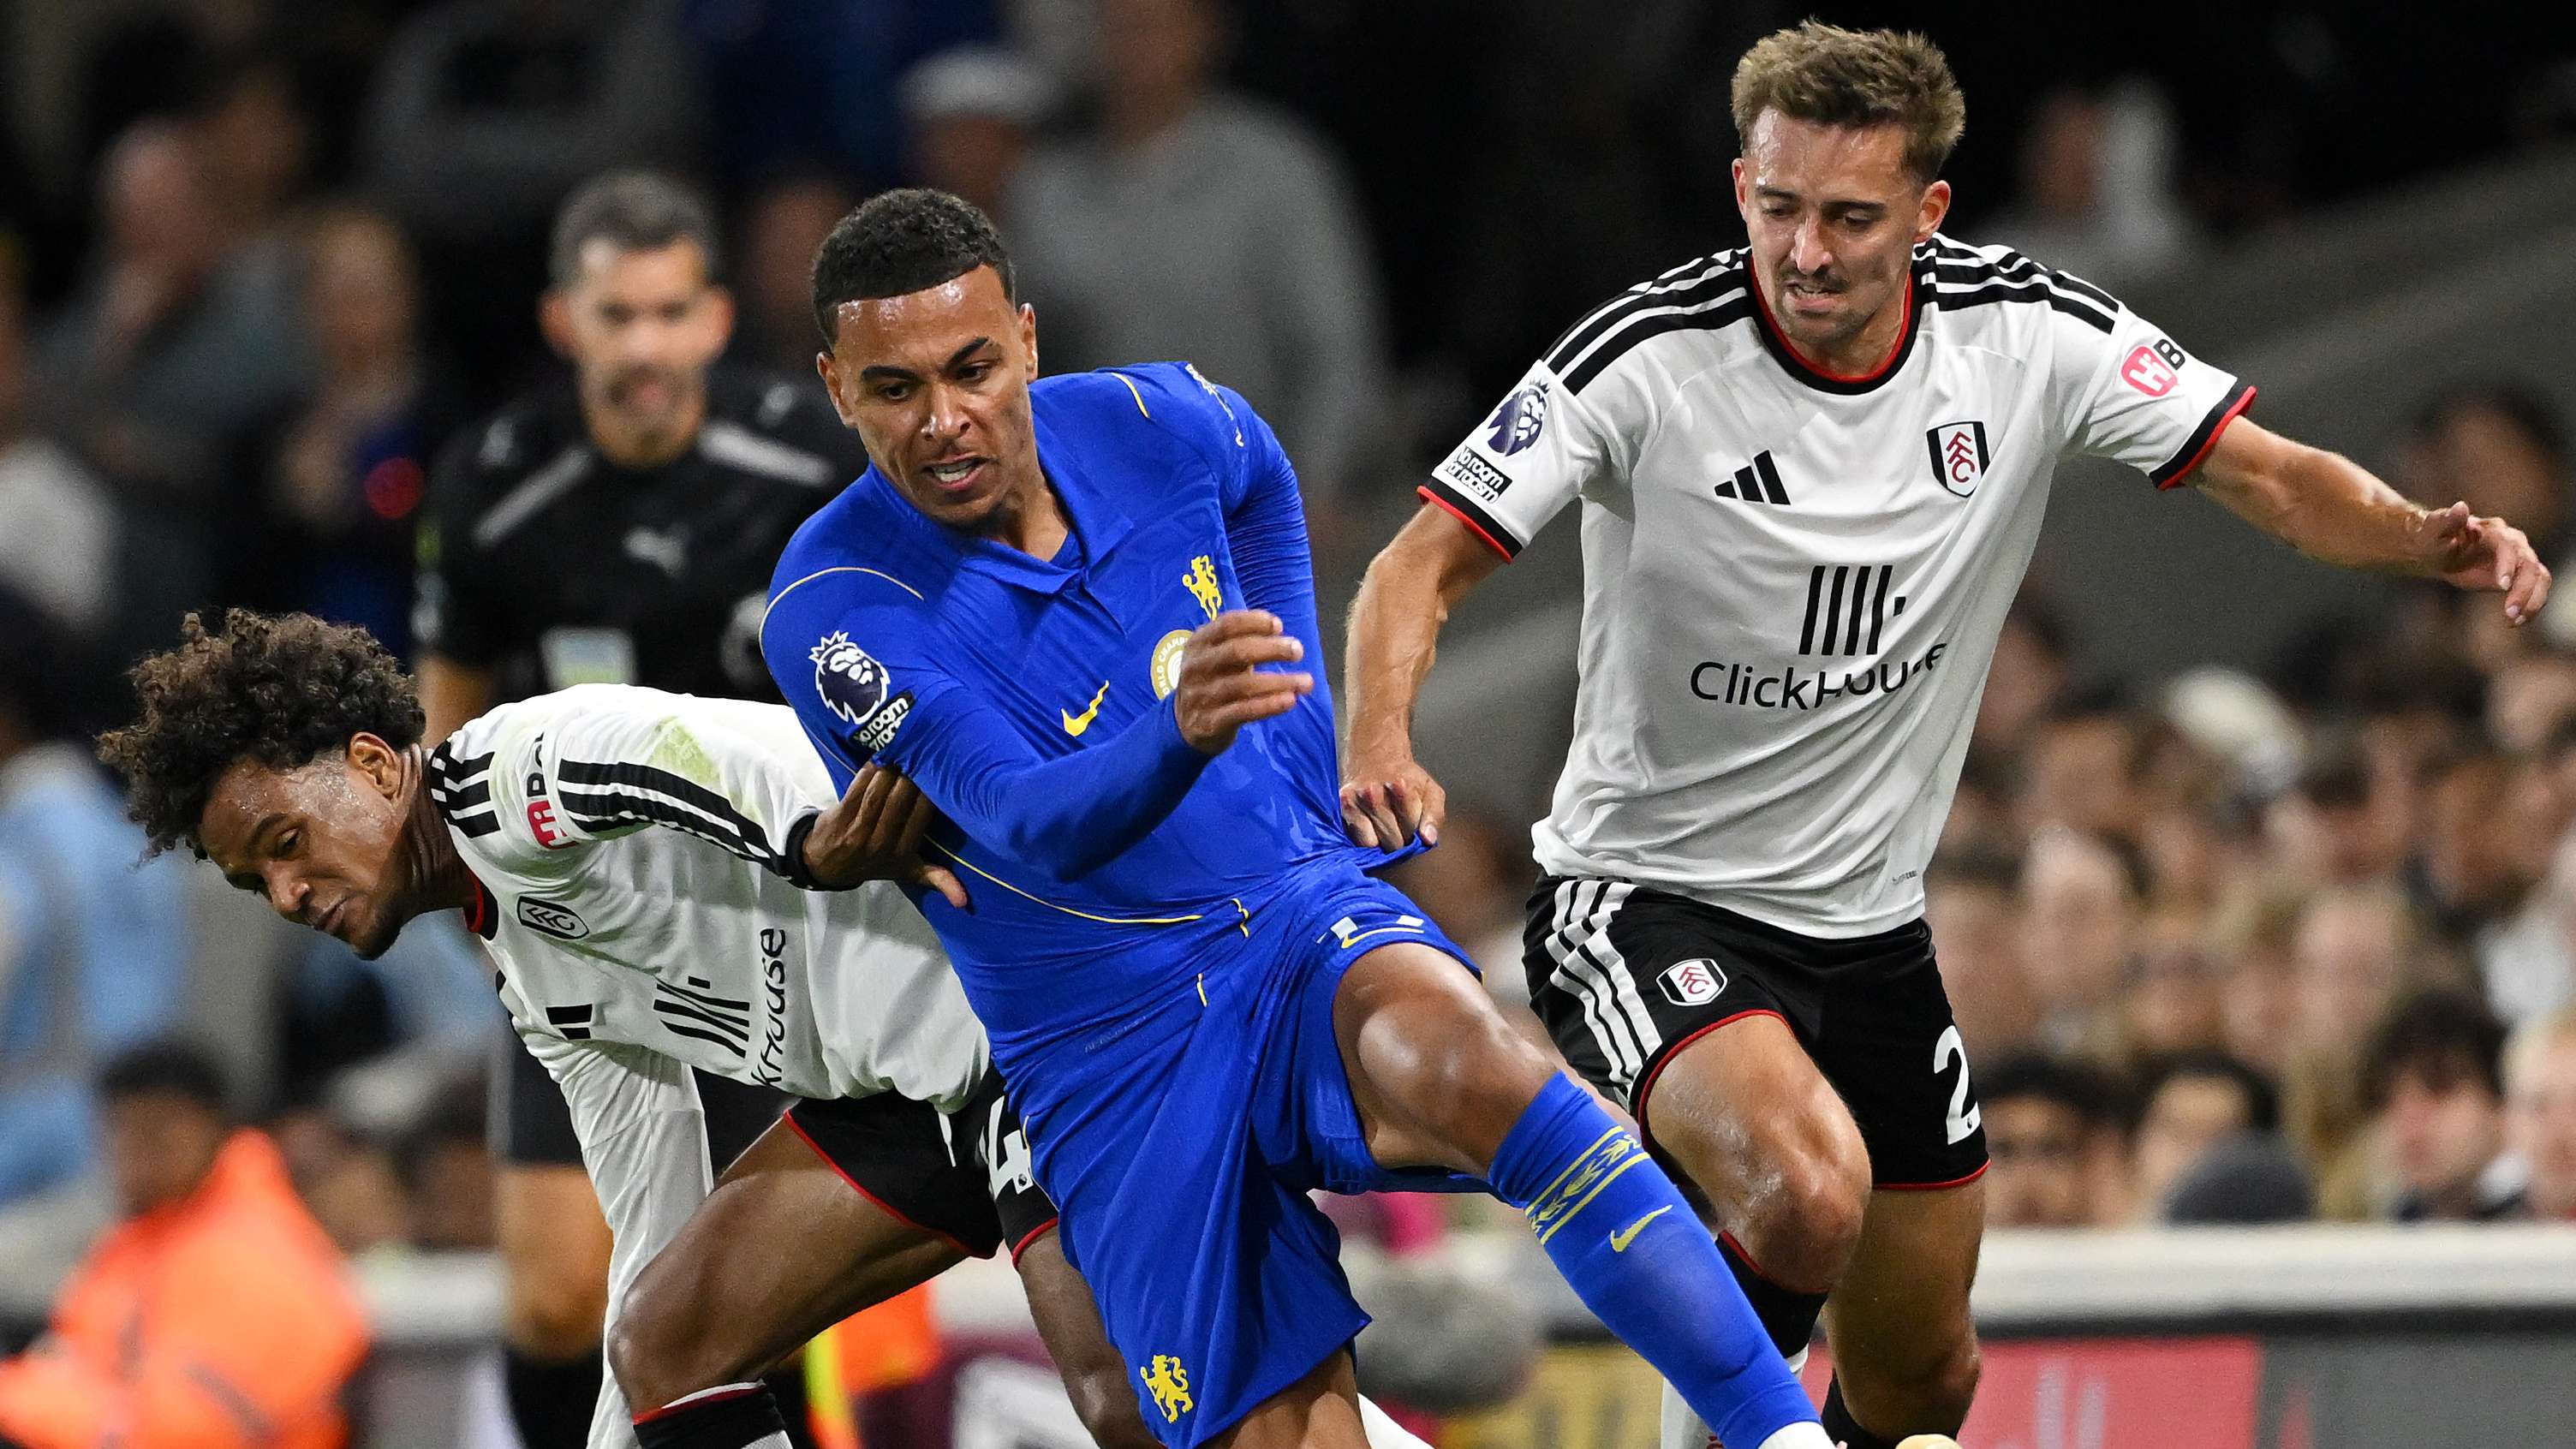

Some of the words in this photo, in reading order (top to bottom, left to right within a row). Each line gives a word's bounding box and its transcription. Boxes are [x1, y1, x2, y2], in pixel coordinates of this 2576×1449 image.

[1466, 456, 1505, 490] room
[1946, 431, 1976, 483] FFC
[867, 698, 909, 736] room
[525, 907, 575, 931] FFC
[1679, 967, 1710, 994] FFC
[1933, 1024, 1982, 1145] 2
[975, 1095, 1035, 1201] 4
